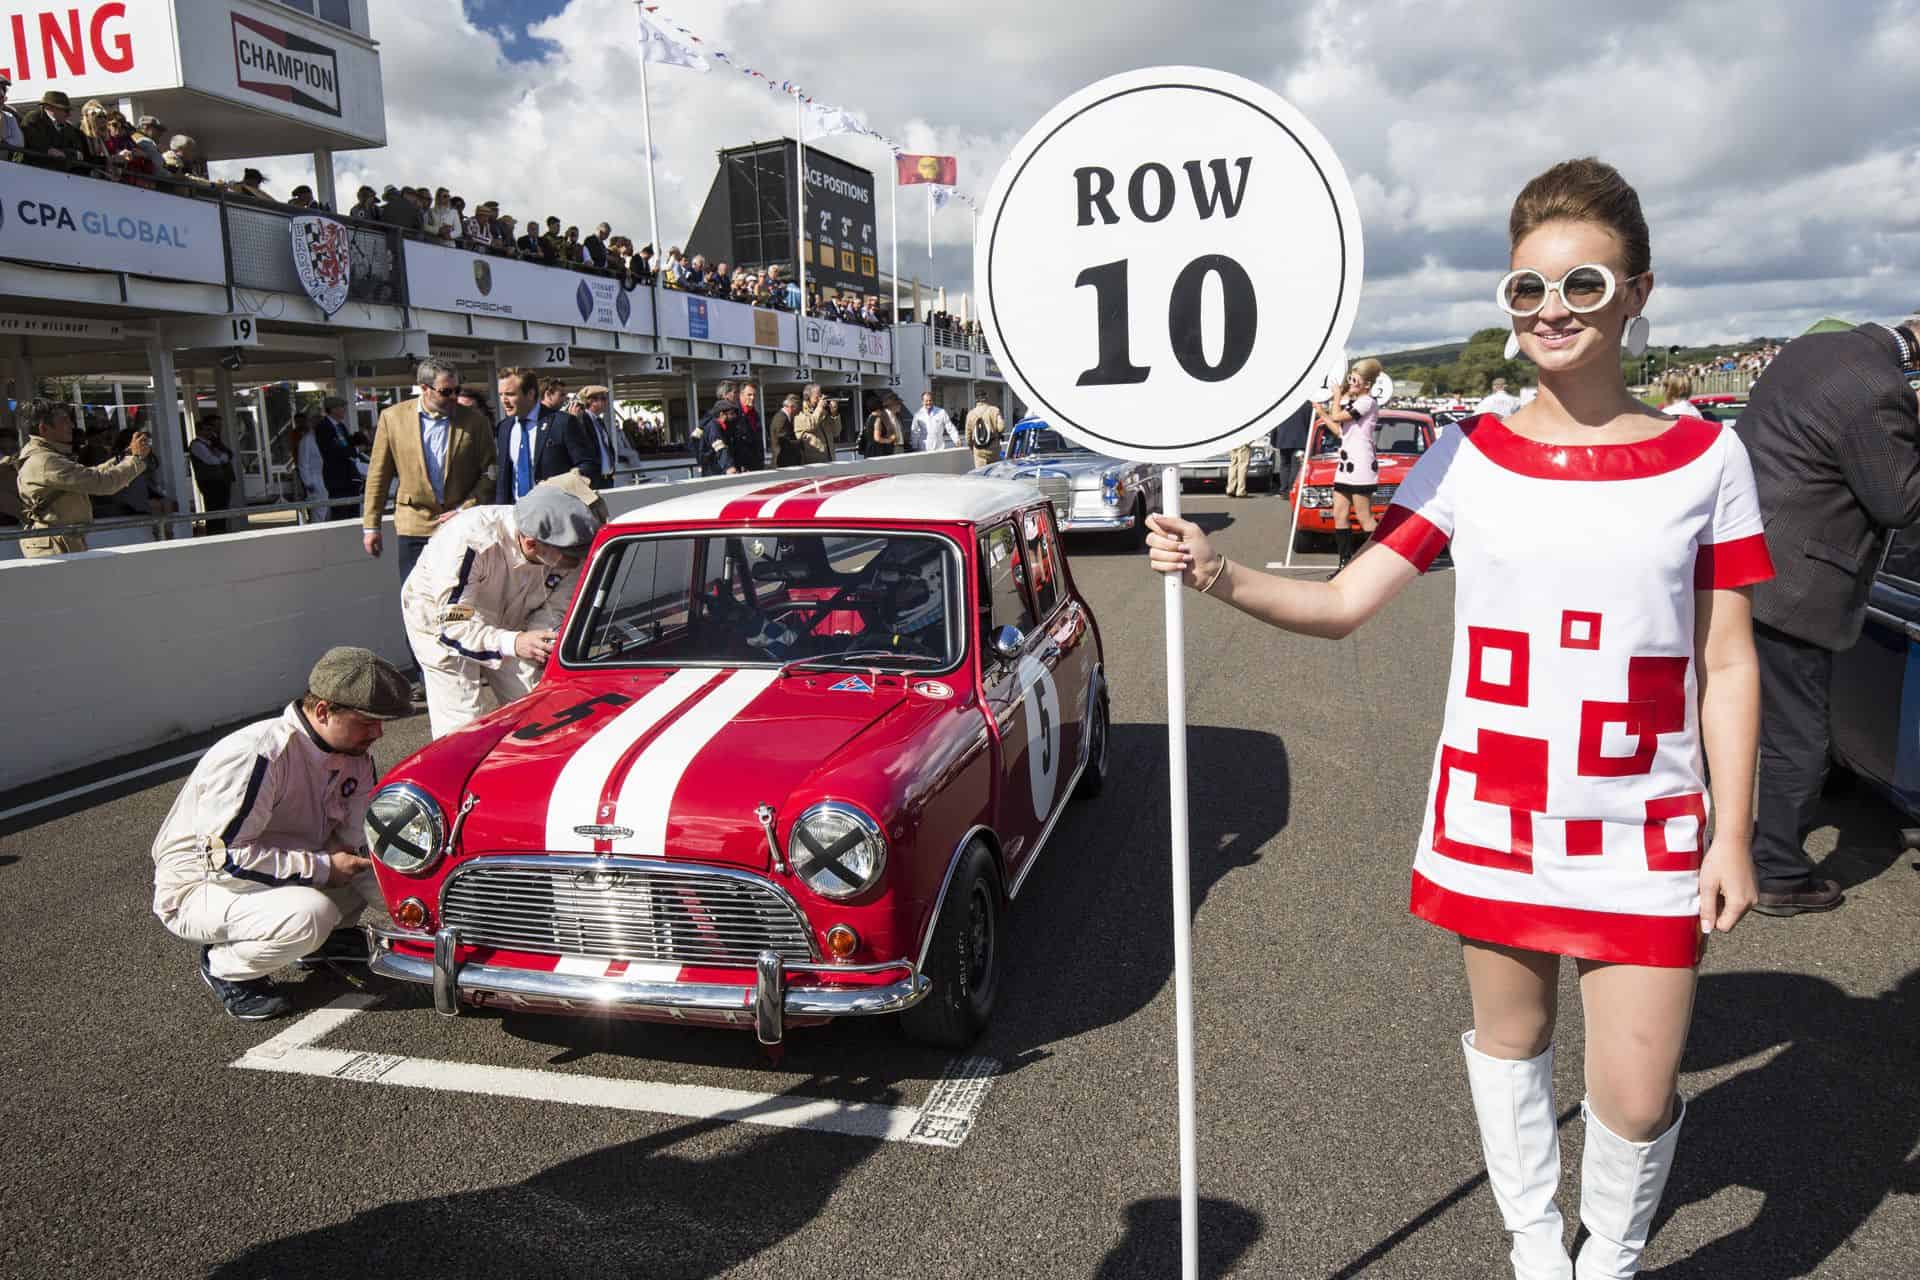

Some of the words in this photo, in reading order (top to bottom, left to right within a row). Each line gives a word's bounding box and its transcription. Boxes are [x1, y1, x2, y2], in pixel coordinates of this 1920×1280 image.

[238, 39, 334, 92] CHAMPION
[804, 163, 823, 187] ACE
[823, 174, 869, 204] POSITIONS
[1073, 156, 1252, 226] ROW
[17, 200, 76, 232] CPA
[81, 211, 187, 249] GLOBAL
[455, 299, 512, 313] PORSCHE
[231, 319, 252, 340] 19
[1074, 253, 1258, 386] 10
[546, 347, 566, 363] 20
[655, 356, 670, 370] 21
[731, 363, 748, 375] 22
[795, 368, 810, 380] 23
[846, 372, 859, 384] 24
[888, 375, 901, 387] 25
[512, 692, 632, 740] 5
[1033, 677, 1051, 776] 5
